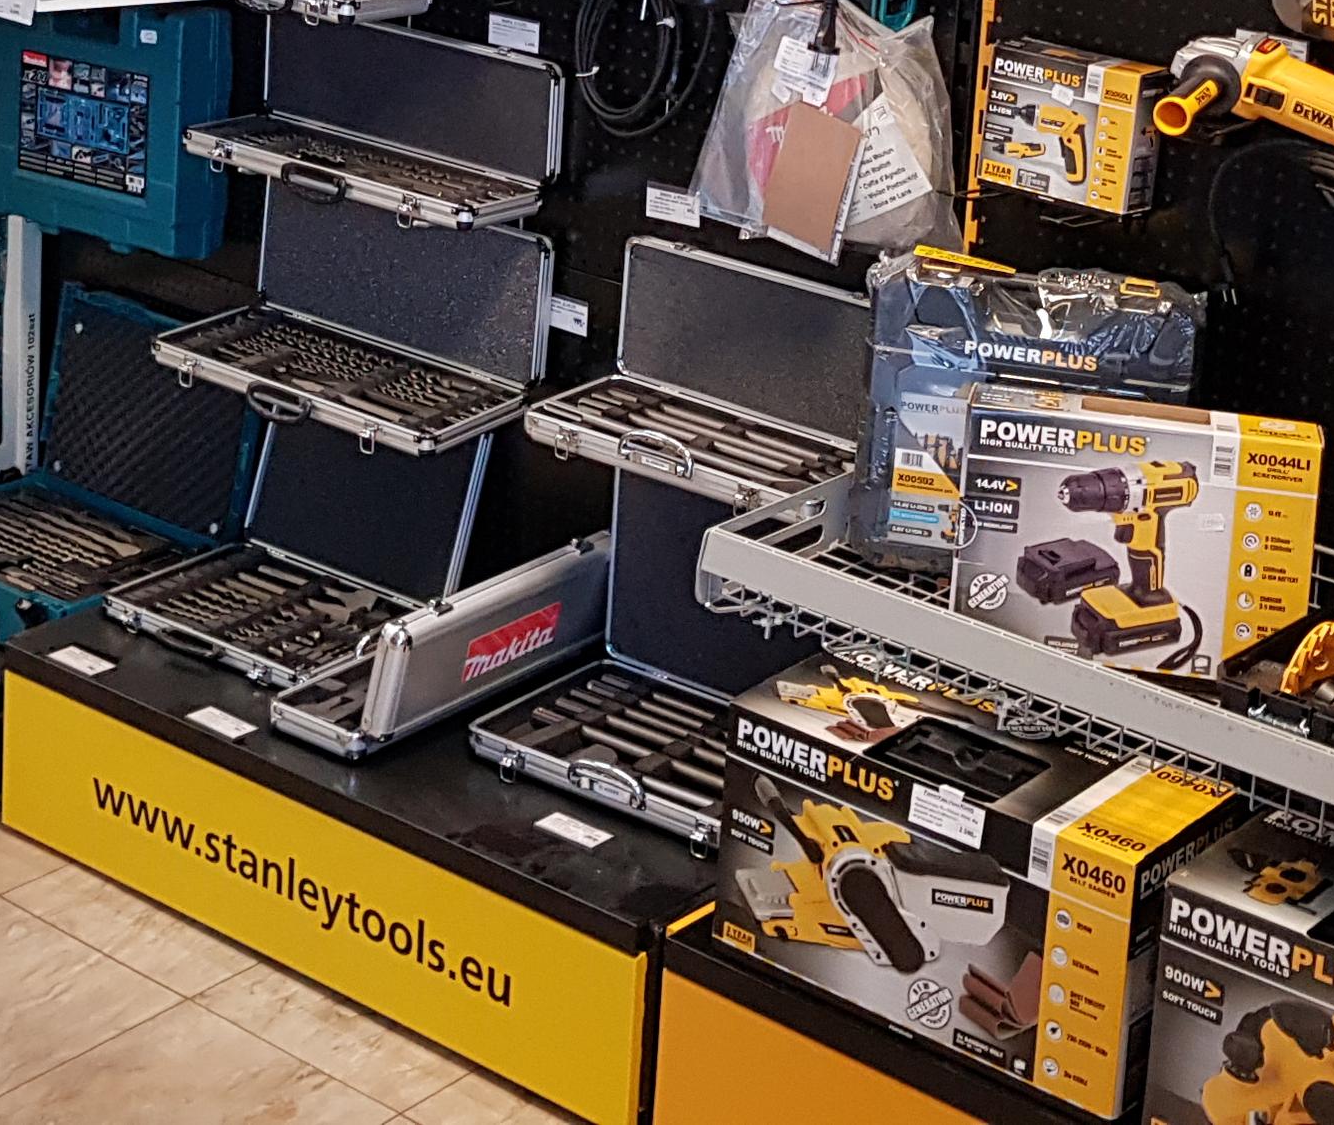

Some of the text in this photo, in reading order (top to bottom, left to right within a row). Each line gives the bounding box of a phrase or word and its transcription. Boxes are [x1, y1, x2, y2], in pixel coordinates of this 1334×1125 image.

[995, 58, 1082, 87] POWERPLUS
[963, 339, 1097, 372] POWERPLUS
[980, 420, 1147, 456] POWERPLUS
[980, 438, 1075, 455] HIGH QUALITY TOOLS
[1247, 453, 1311, 471] X0044LI
[976, 479, 1006, 490] 14.4V
[974, 503, 1013, 514] LI-ION
[464, 622, 559, 680] makita
[737, 738, 826, 782] HIGH QUALITY TOOLS
[738, 717, 895, 801] POWERPLUS
[732, 809, 760, 830] 950W
[746, 835, 770, 852] TOUCH
[1078, 822, 1147, 852] X0460
[1062, 853, 1126, 894] X0460
[1069, 876, 1087, 888] BELT
[92, 773, 514, 1007] www.stanleytools.eu
[935, 892, 989, 909] POWERPLUS
[1169, 922, 1289, 978] HIGH QUALITY TOOLS
[1165, 965, 1205, 993] 900W
[1163, 991, 1217, 1019] SOFT TOUCH
